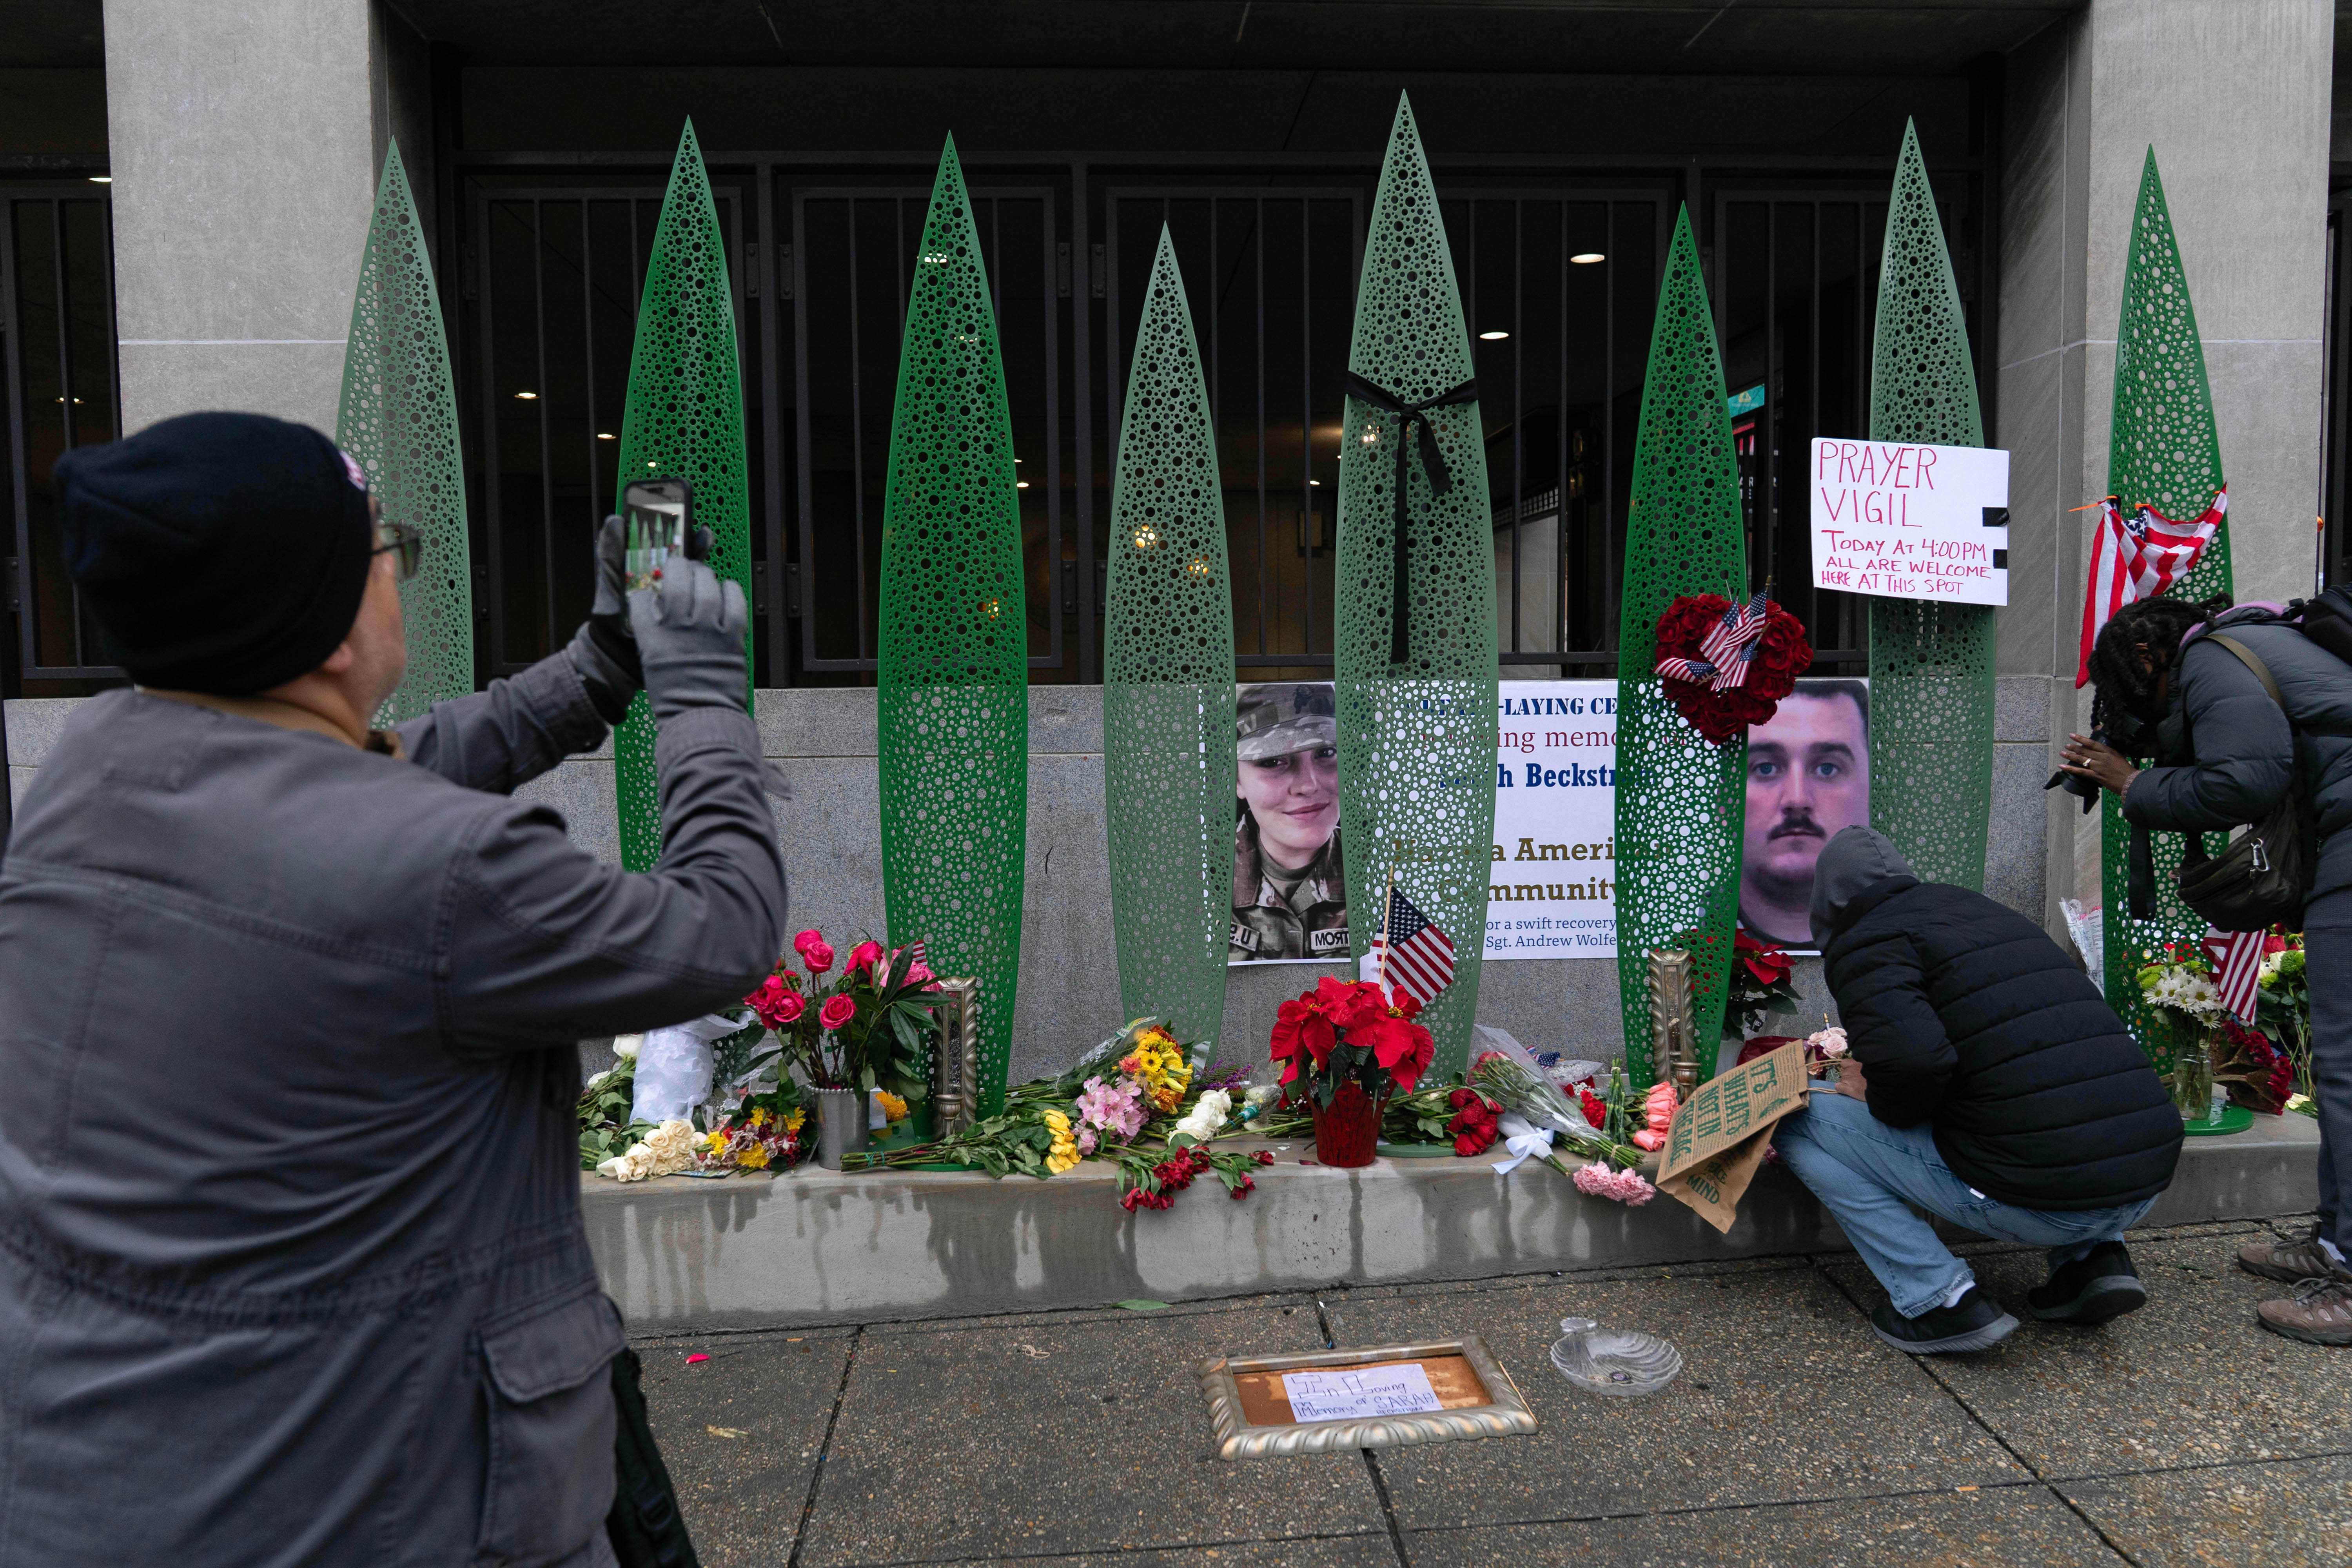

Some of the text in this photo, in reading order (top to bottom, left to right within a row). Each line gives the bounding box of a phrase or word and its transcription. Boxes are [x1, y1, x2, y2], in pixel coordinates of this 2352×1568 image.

[1819, 442, 1937, 490] PRAYER
[1821, 487, 1922, 527] VIGIL
[1821, 530, 1885, 556] TODAY
[1893, 539, 1914, 555] AT
[1826, 556, 1991, 578] ALL ARE WELCOME
[1822, 571, 1964, 594] HERE AT THIS SPOT
[1514, 837, 1615, 861] Ameri
[1486, 917, 1617, 931] or a swift recovery
[1486, 936, 1511, 950] Sgt.
[1515, 935, 1572, 947] Andrew
[1576, 933, 1616, 946] Wolfe
[1751, 1057, 1777, 1094] IT'S
[1698, 1085, 1719, 1118] NOT
[1724, 1070, 1749, 1135] WHAT'S
[1698, 1116, 1721, 1140] IN
[1686, 1174, 1720, 1204] MIND
[1290, 1374, 1406, 1398] In Loving
[1294, 1401, 1358, 1416] Memory
[1374, 1392, 1433, 1408] SARAH
